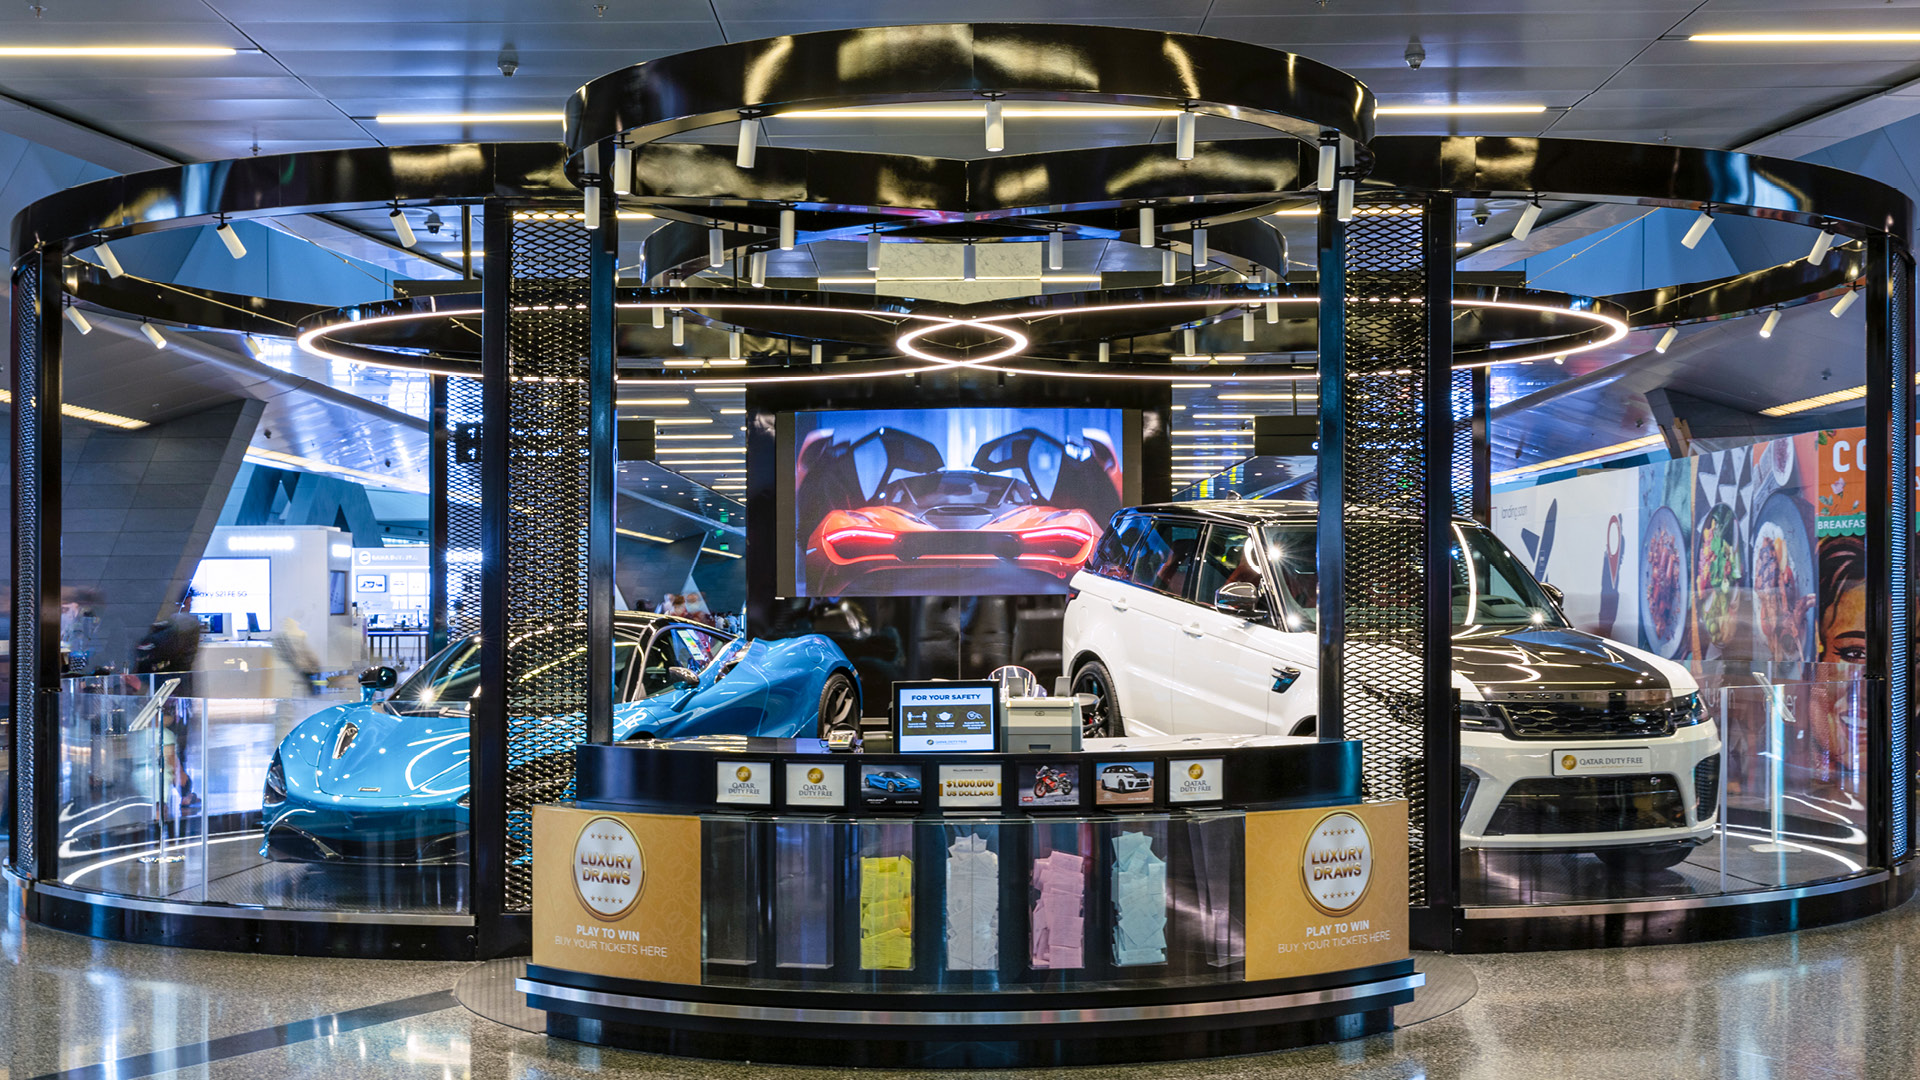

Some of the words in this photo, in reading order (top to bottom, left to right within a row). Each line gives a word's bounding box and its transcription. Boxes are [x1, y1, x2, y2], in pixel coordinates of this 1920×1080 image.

[1832, 438, 1866, 473] CO
[1817, 519, 1866, 530] BREAKFAS
[1579, 758, 1604, 766] QATAR
[1605, 757, 1626, 765] DUTY
[1626, 756, 1643, 764] FREE
[731, 782, 756, 790] QATAR
[946, 780, 994, 788] $1,000,000
[1183, 780, 1207, 788] QATAR
[580, 851, 634, 869] LUXURY
[1311, 846, 1365, 865] LUXURY
[582, 868, 631, 885] DRAWS
[1313, 862, 1362, 881] DRAWS
[576, 924, 600, 937] PLAY
[602, 928, 615, 939] TO
[618, 930, 640, 941] WIN
[1306, 924, 1333, 937] PLAY
[1334, 922, 1348, 934] TO
[1350, 920, 1370, 932] WIN
[554, 935, 572, 945] BUY
[573, 938, 598, 949] YOUR
[600, 941, 639, 955] TICKETS
[640, 945, 668, 958] HERE
[1278, 943, 1300, 954] BUY
[1302, 939, 1330, 950] YOUR
[1332, 934, 1368, 948] TICKETS
[1369, 930, 1391, 943] HERE
